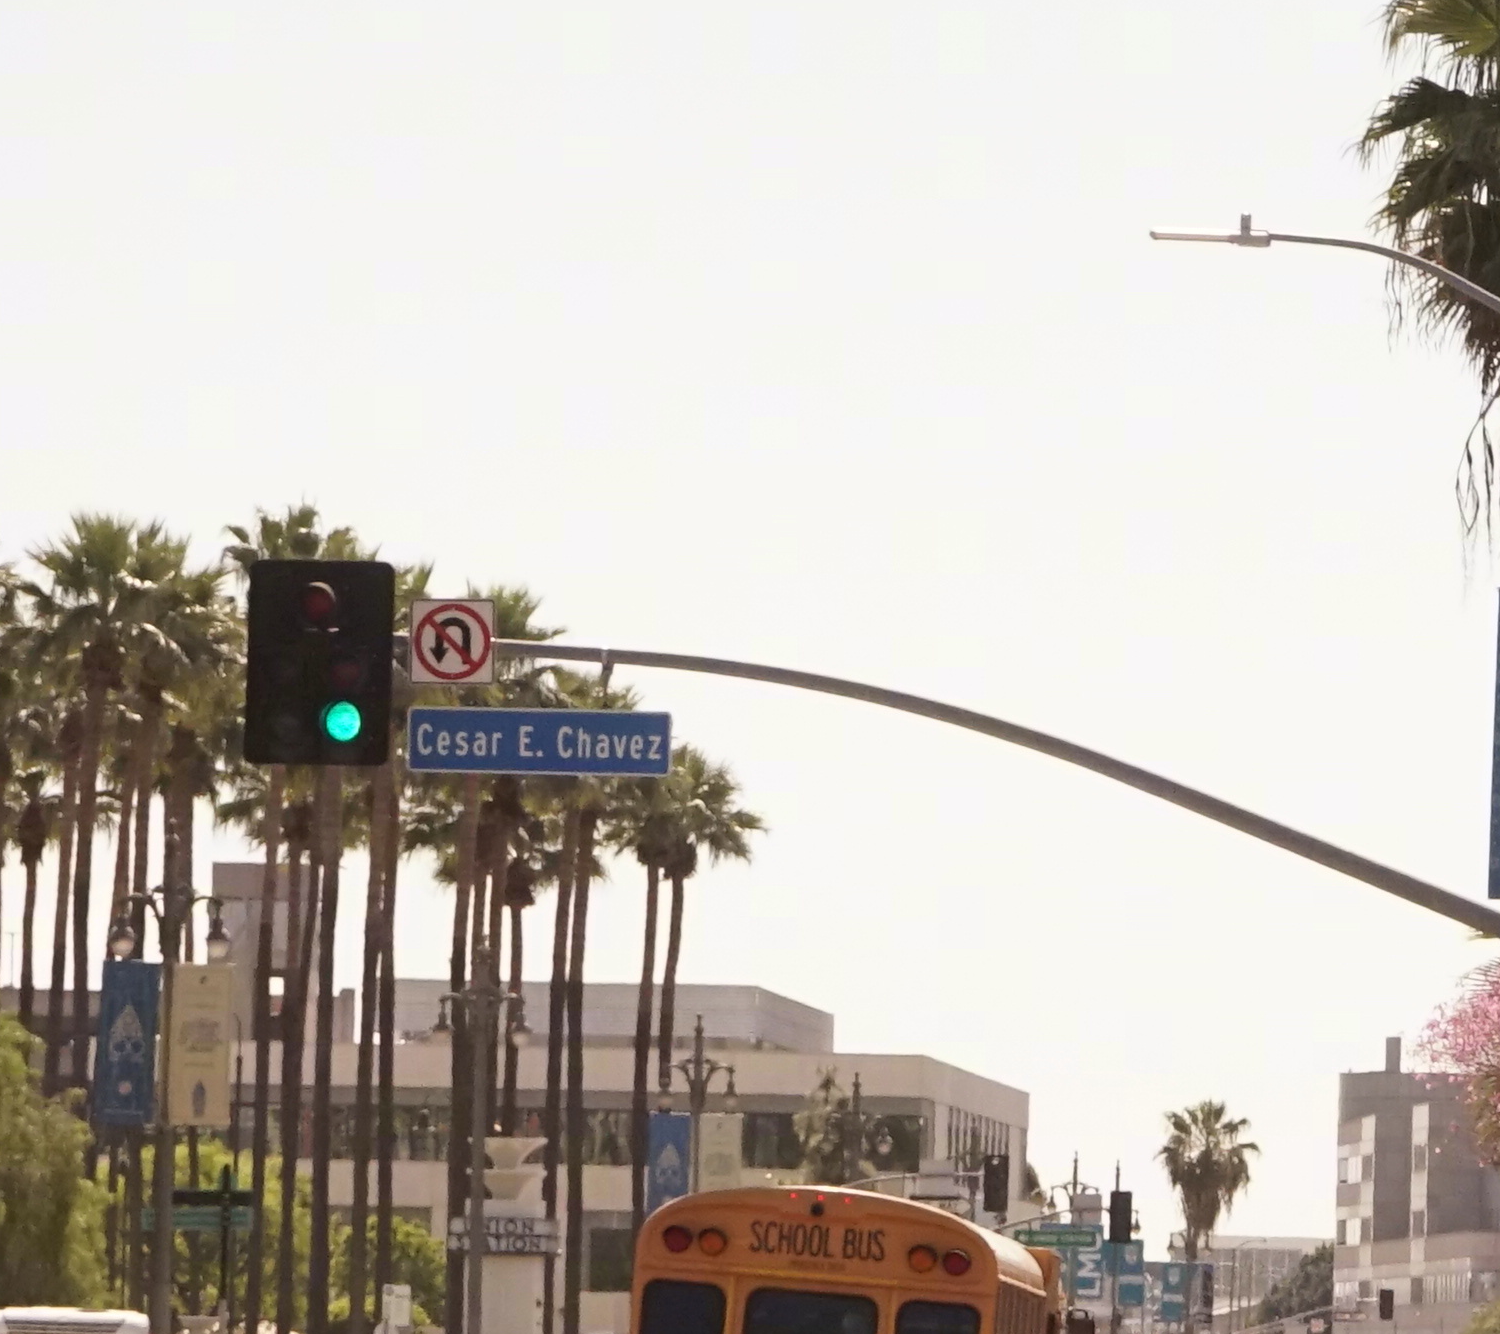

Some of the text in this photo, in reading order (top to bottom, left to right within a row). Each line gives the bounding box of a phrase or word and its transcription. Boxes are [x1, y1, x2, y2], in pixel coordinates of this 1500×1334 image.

[416, 723, 663, 760] Cesar E. Chavez
[749, 1220, 887, 1262] SCHOOL BUS
